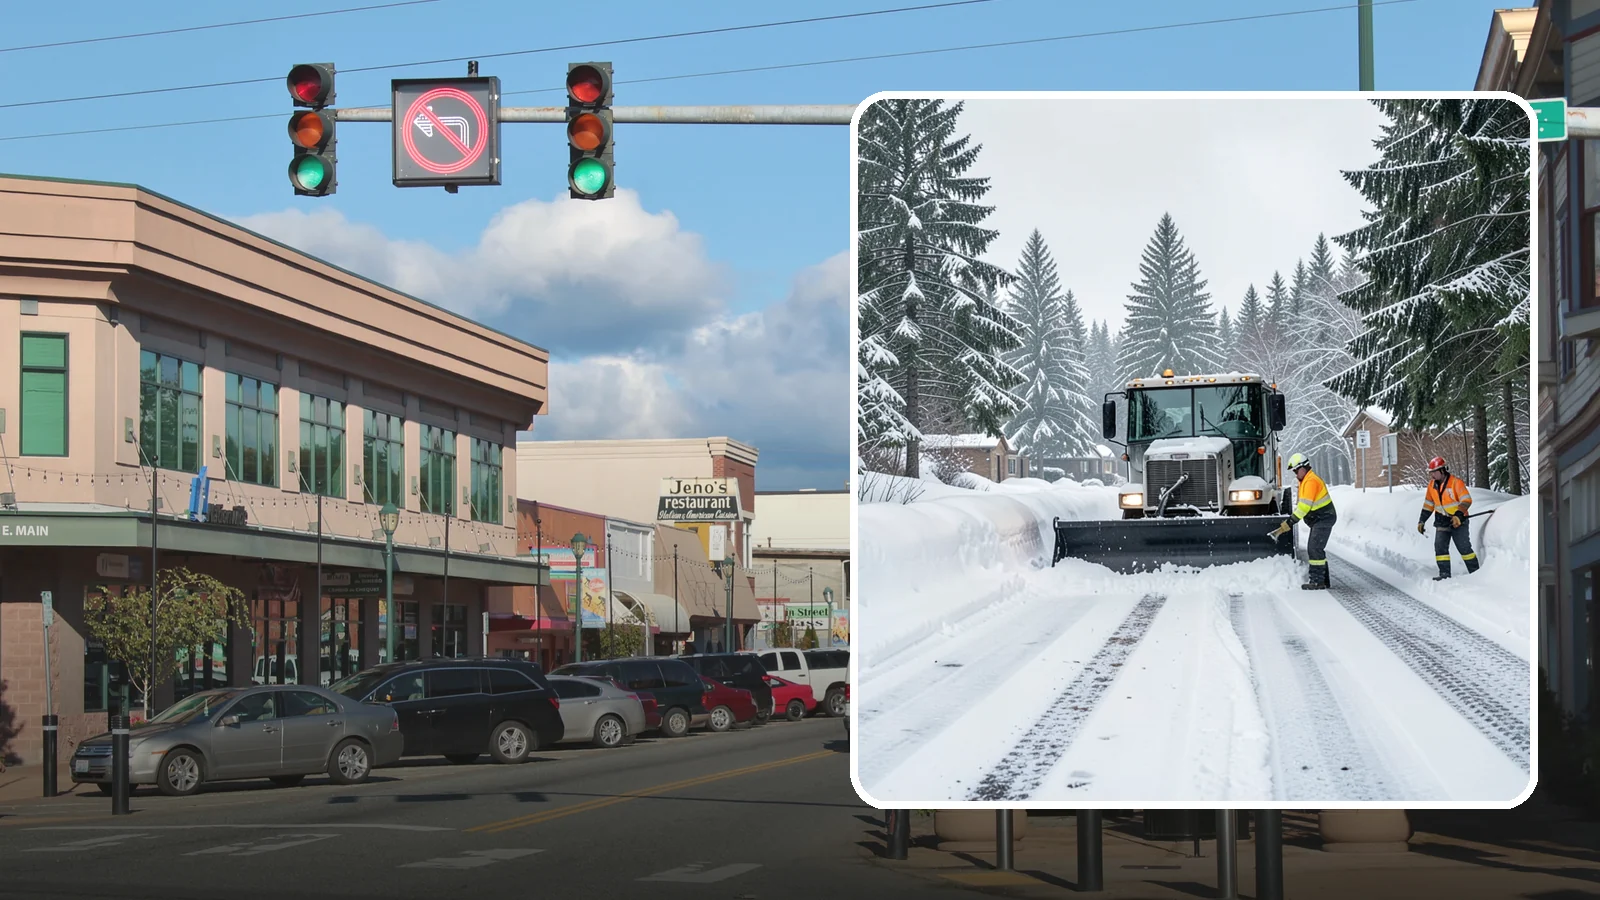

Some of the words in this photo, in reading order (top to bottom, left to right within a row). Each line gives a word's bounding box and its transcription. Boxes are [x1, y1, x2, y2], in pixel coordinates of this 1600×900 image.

[669, 480, 727, 494] Jeno's
[665, 496, 731, 509] restaurant
[658, 510, 682, 520] Italian
[686, 509, 714, 519] American
[715, 509, 738, 519] Cuisine
[2, 525, 13, 536] E.
[15, 525, 49, 536] MAIN
[797, 607, 828, 617] Street
